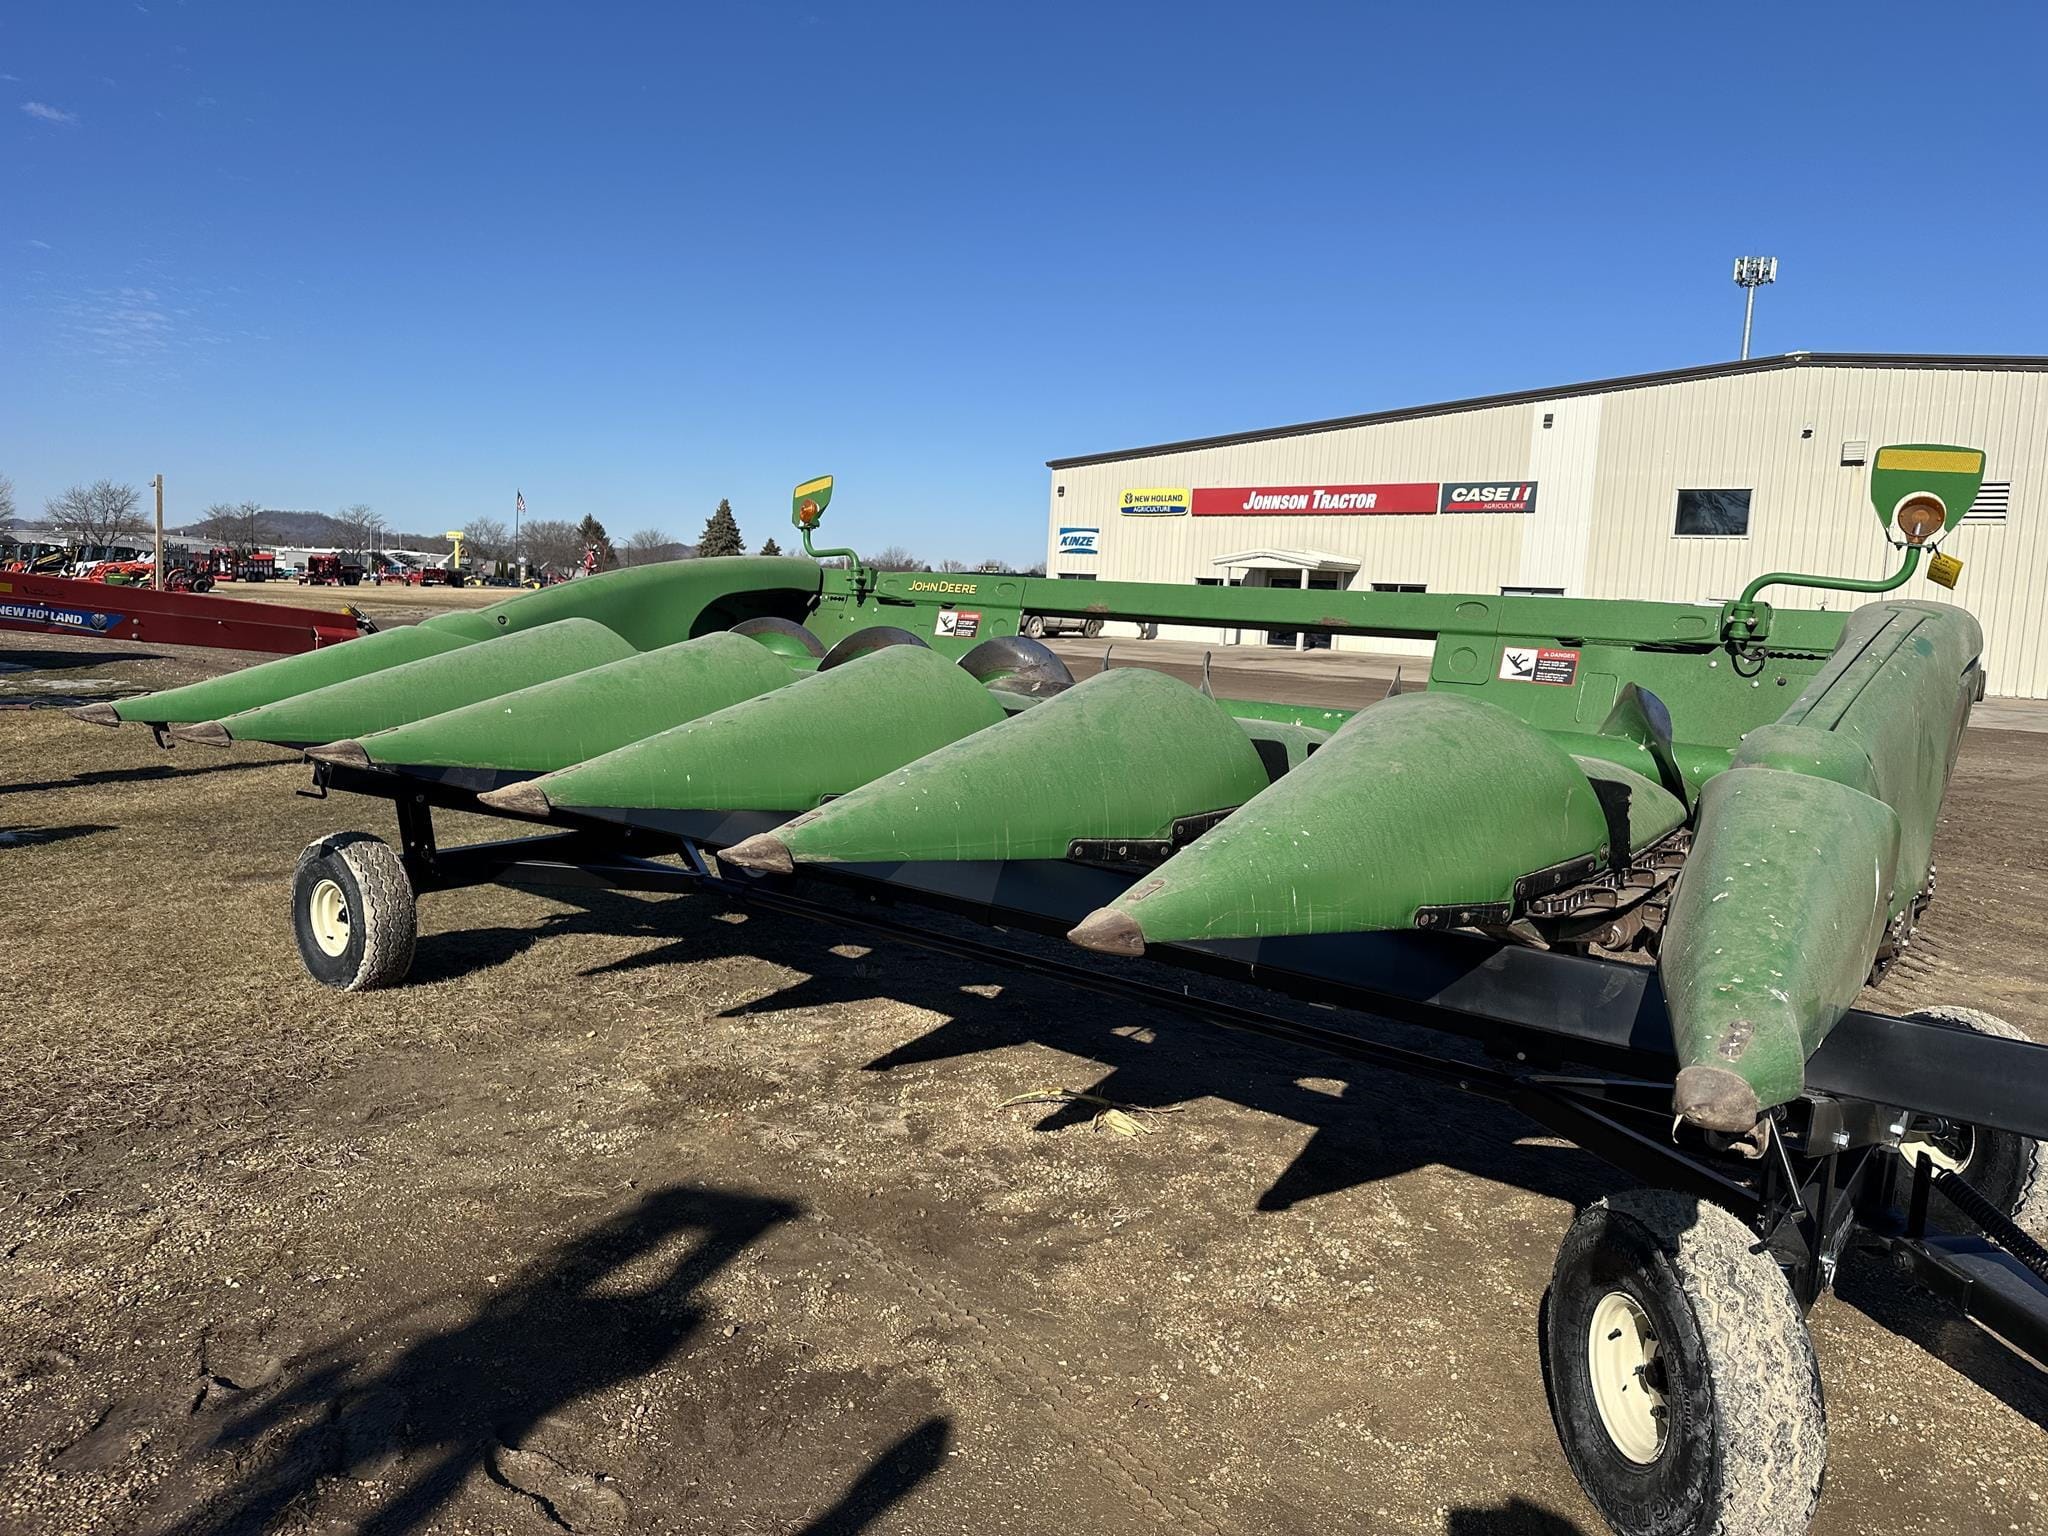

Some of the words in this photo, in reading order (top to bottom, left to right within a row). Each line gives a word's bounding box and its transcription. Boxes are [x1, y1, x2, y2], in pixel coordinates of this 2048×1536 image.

[1151, 494, 1183, 502] HOLLAND
[1243, 491, 1309, 510] JOHNSON
[1312, 490, 1377, 509] TRACTOR
[1451, 486, 1511, 502] CASE
[1060, 536, 1095, 546] KINZE
[908, 580, 938, 592] JOHN
[939, 581, 977, 594] DEERE
[0, 605, 24, 616] NEW
